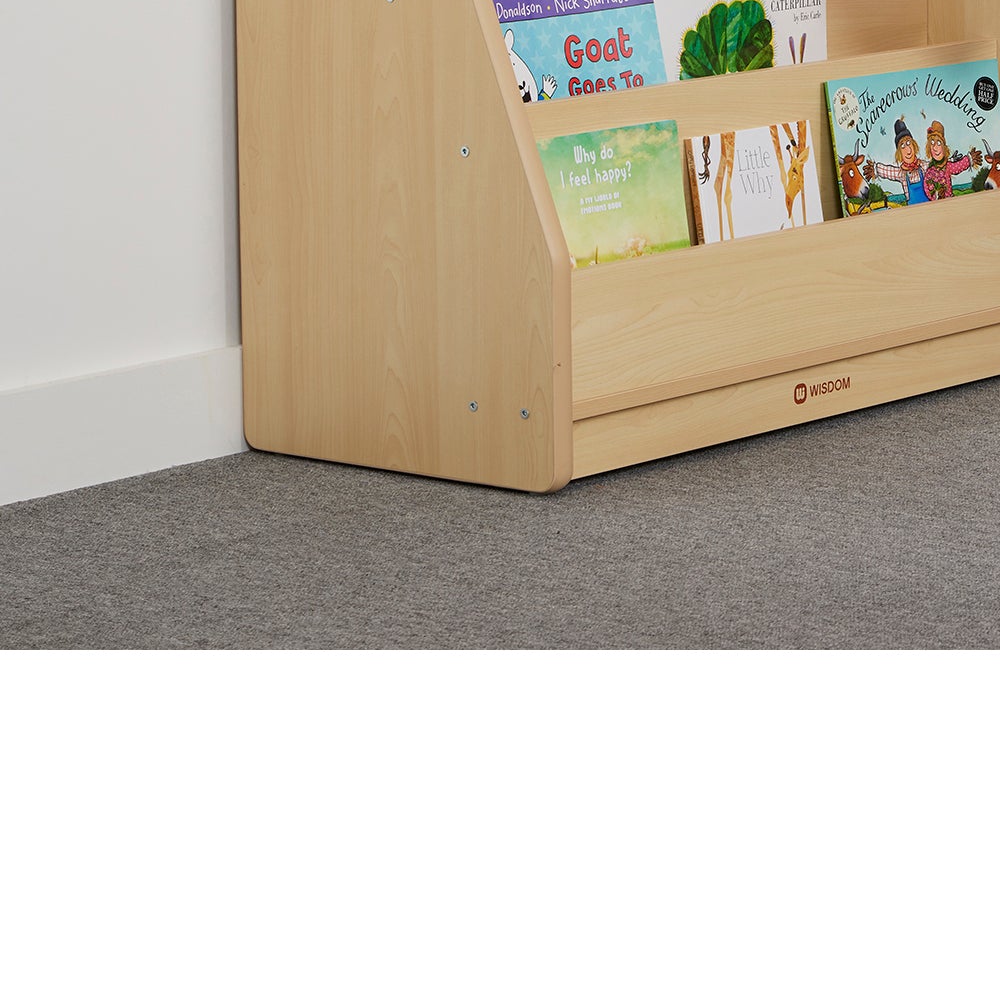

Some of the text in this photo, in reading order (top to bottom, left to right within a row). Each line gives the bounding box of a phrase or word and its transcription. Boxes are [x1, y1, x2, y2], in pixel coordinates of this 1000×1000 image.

[496, 1, 543, 21] Donaldson
[564, 27, 634, 69] Goat
[619, 70, 645, 89] To
[859, 86, 876, 113] The
[924, 73, 987, 133] Wedding
[573, 142, 614, 166] Why do
[736, 145, 772, 172] Little
[560, 161, 633, 189] I feel happy?
[740, 171, 775, 199] Why
[809, 376, 851, 397] WISDOM
